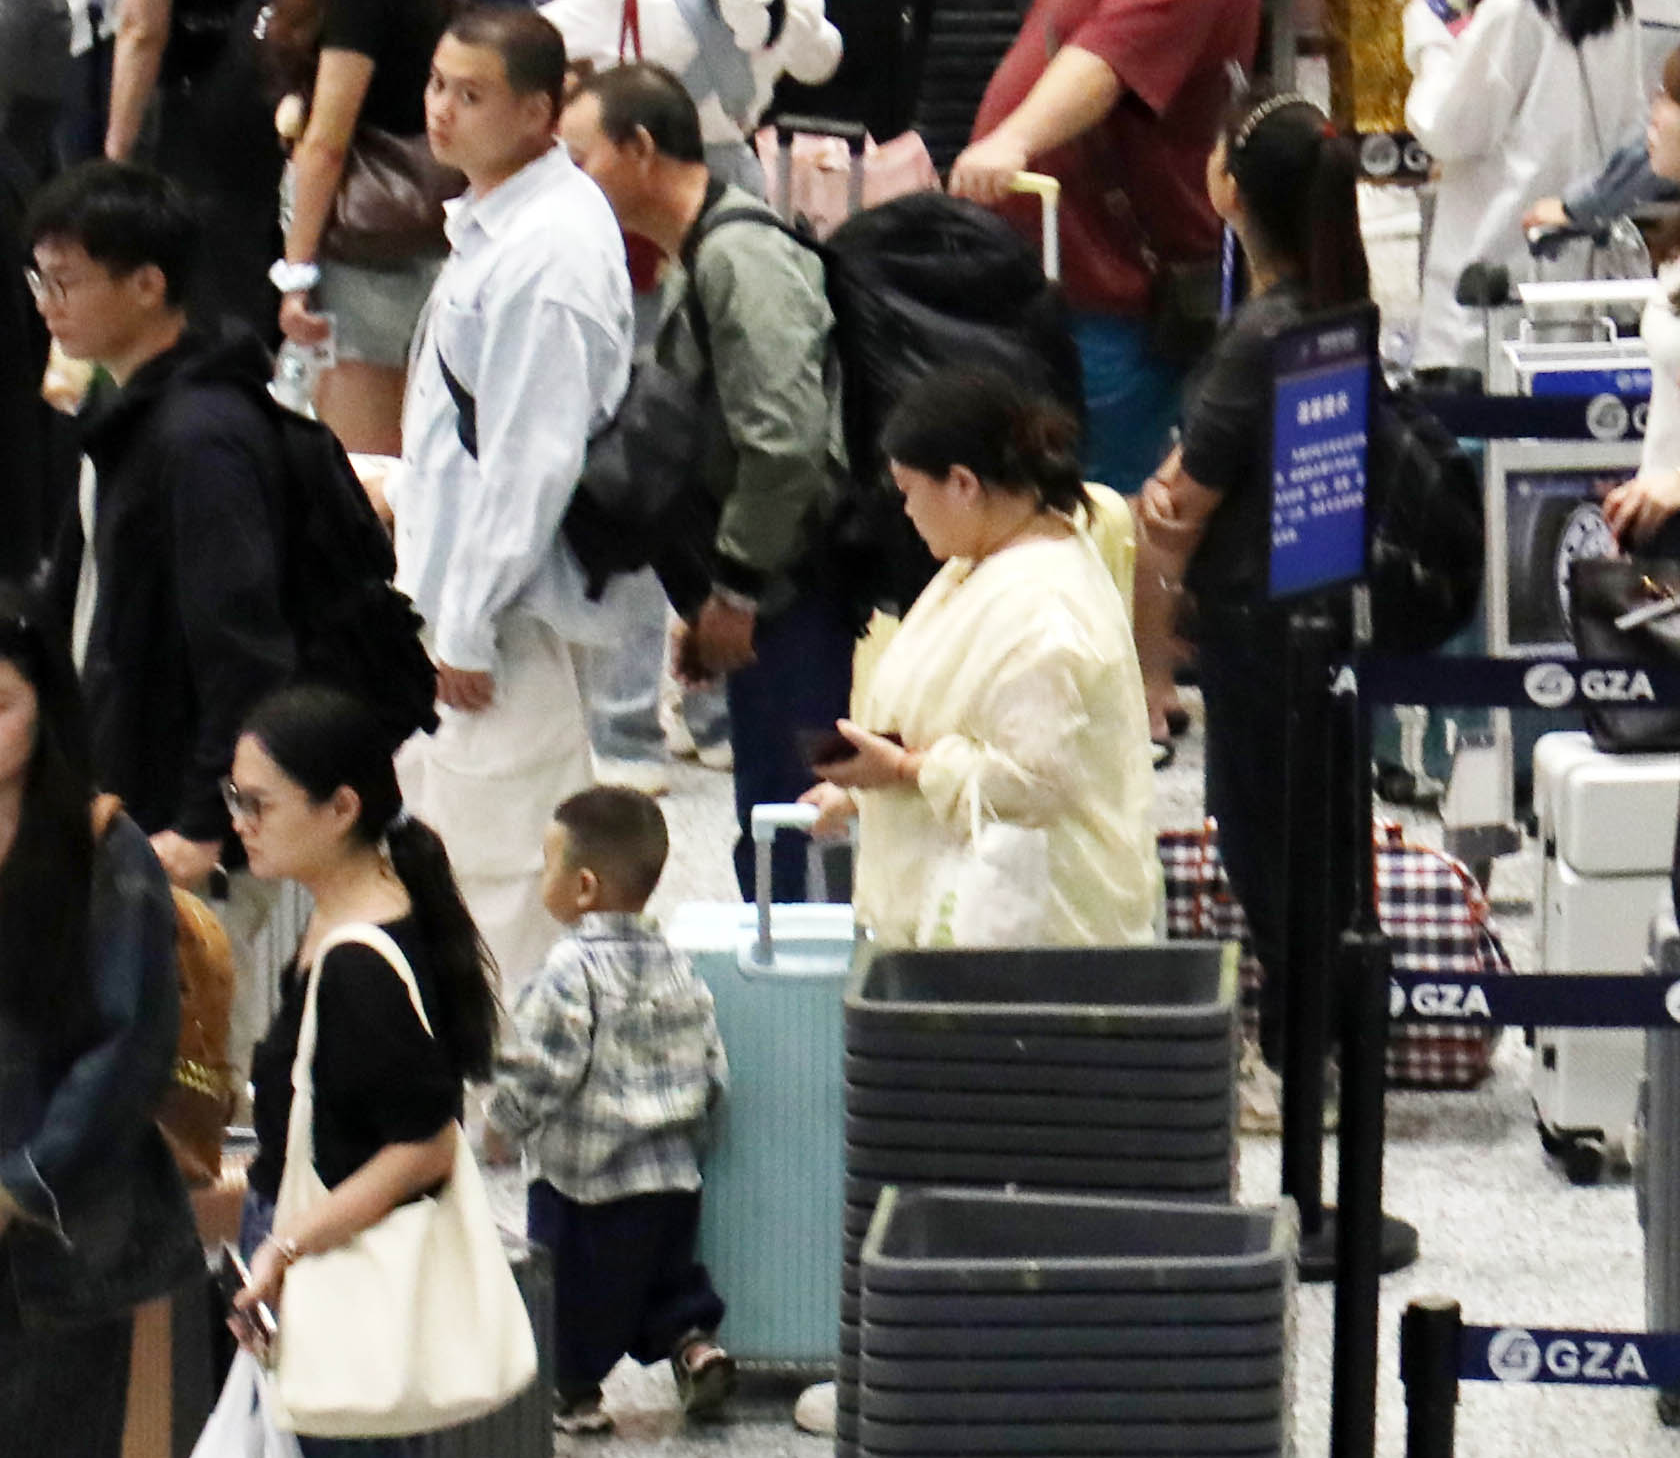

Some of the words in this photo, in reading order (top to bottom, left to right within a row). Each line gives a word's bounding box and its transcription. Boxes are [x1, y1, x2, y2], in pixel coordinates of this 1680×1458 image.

[1580, 669, 1655, 701] GZA
[1411, 983, 1491, 1017] GZA
[1543, 1339, 1648, 1381] GZA
